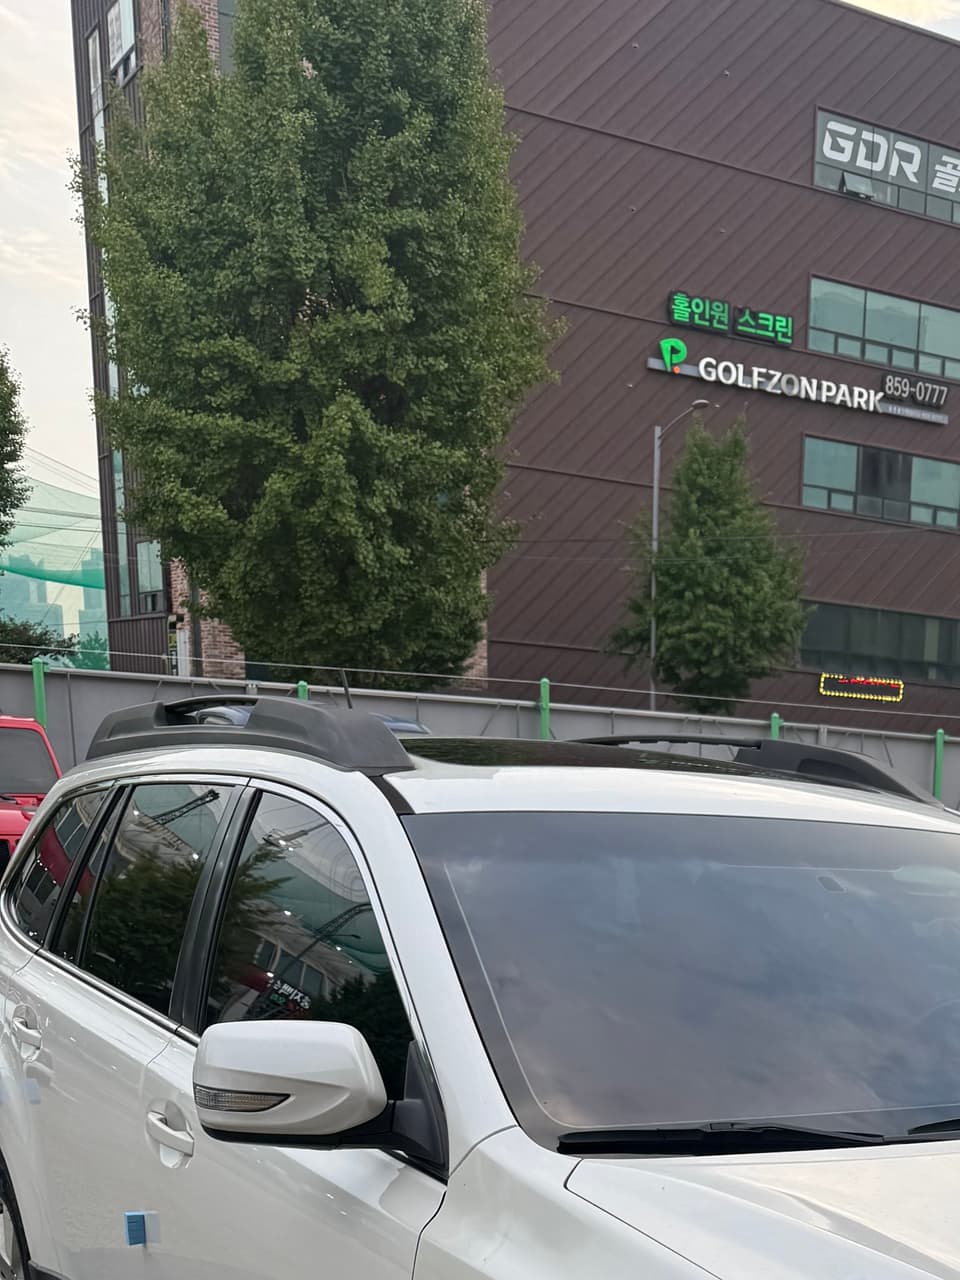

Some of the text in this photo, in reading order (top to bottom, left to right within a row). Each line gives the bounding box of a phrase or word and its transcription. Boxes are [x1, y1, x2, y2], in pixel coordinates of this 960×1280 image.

[822, 120, 922, 183] GDR
[672, 292, 792, 343] 홀인원 스크린
[885, 375, 948, 404] 859-0777
